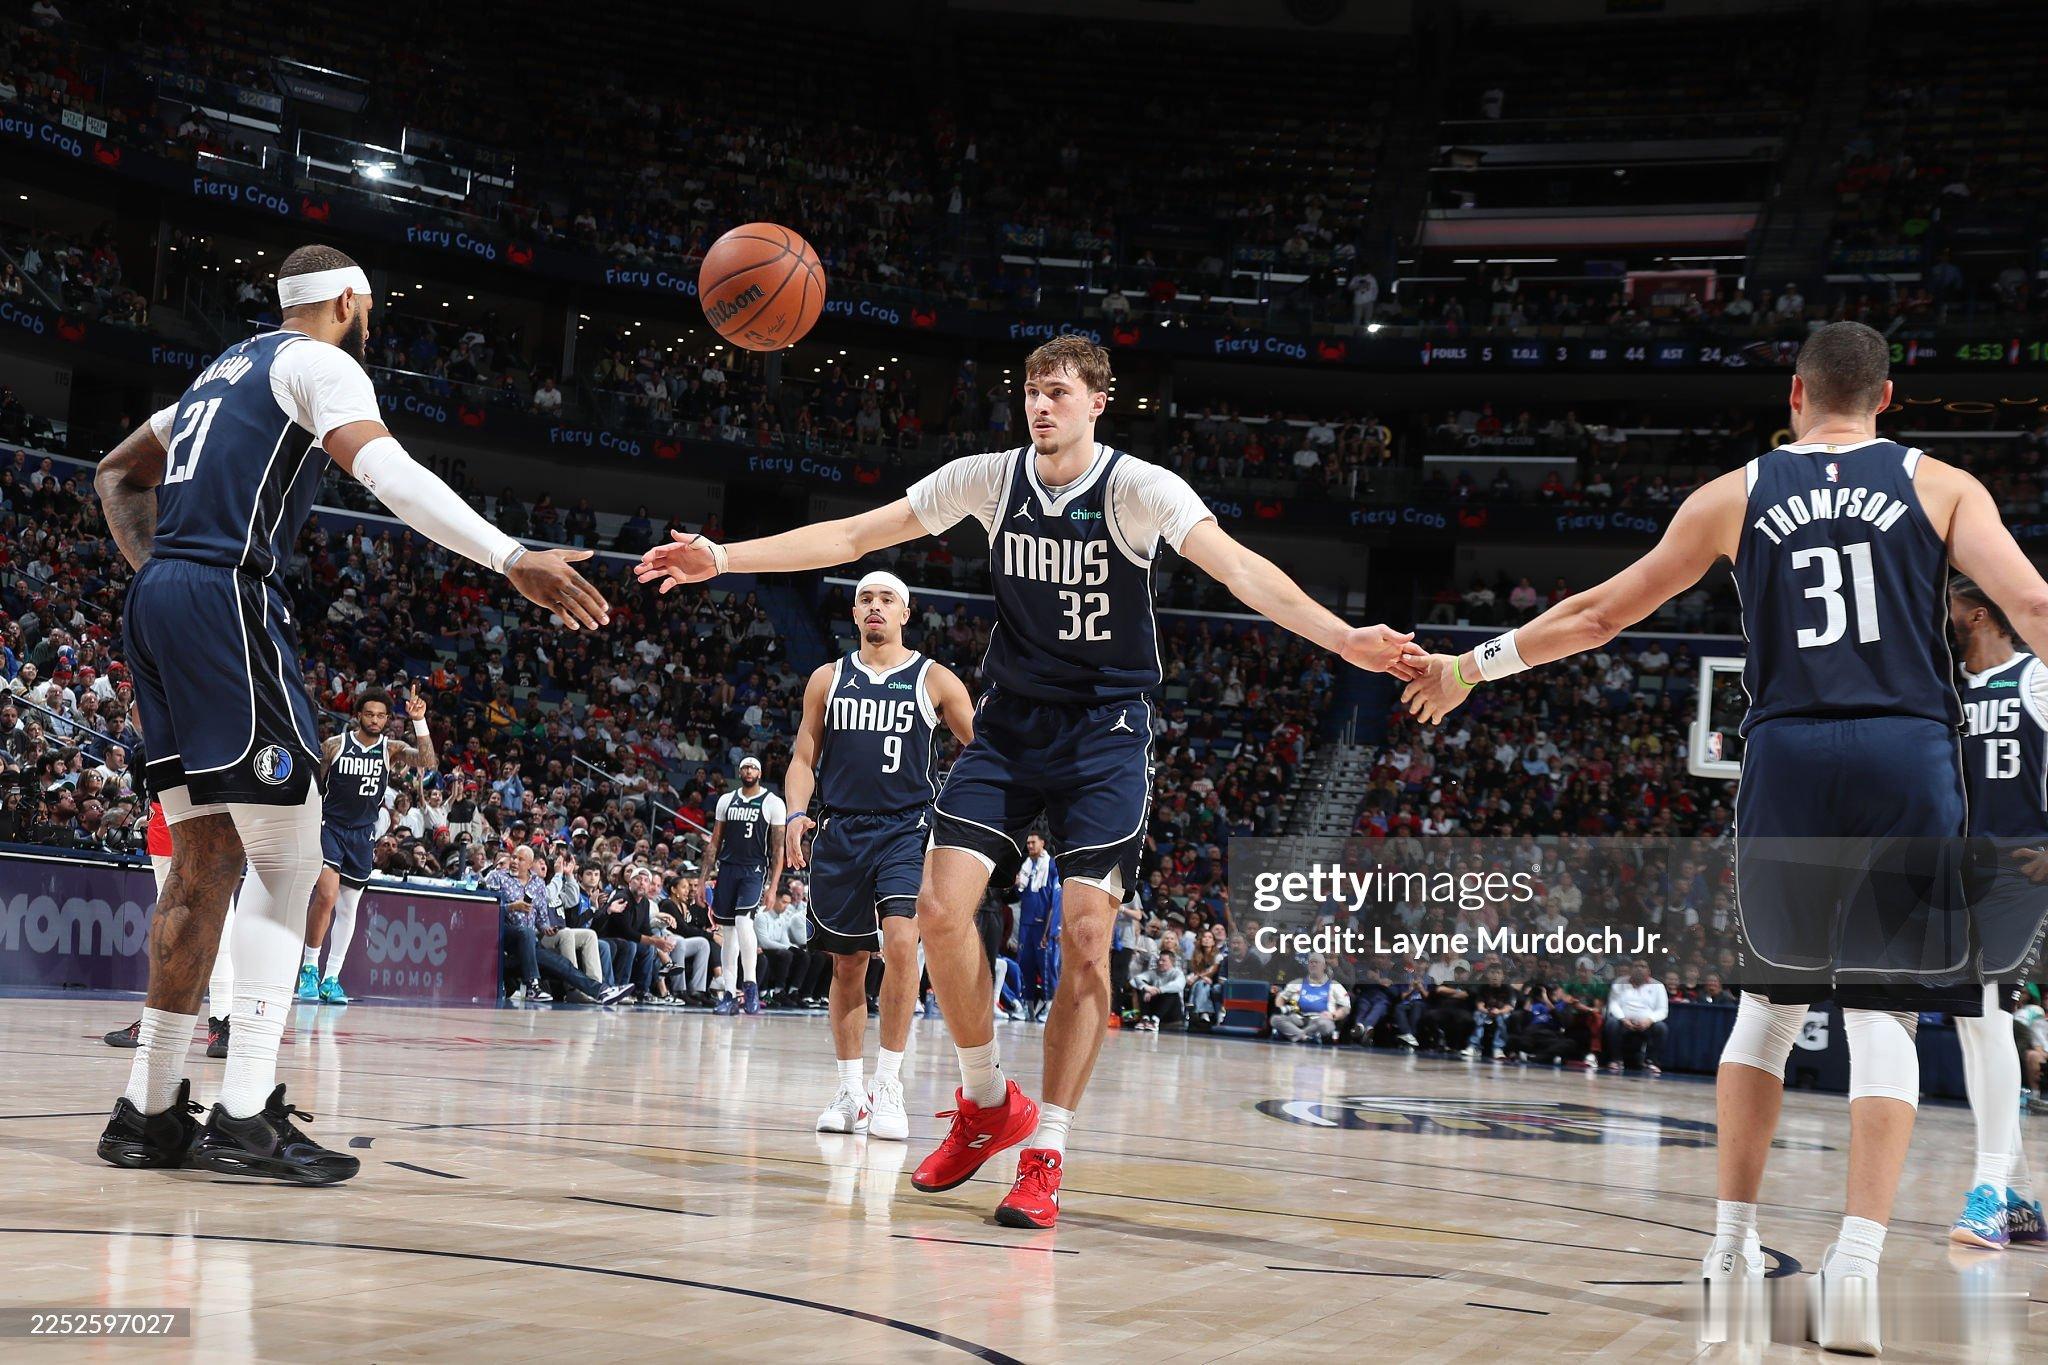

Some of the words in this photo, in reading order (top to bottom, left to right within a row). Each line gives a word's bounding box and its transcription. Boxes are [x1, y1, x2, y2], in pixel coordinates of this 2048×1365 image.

[0, 117, 33, 139] iery
[40, 125, 83, 158] Crab
[193, 178, 238, 201] Fiery
[245, 186, 289, 216] Crab
[407, 226, 450, 248] Fiery
[456, 232, 496, 260] Crab
[606, 269, 650, 288] Fiery
[656, 271, 697, 296] Crab
[0, 302, 45, 335] Crab
[859, 301, 900, 325] Crab
[1009, 322, 1055, 342] Fiery
[152, 347, 195, 369] Fiery
[1215, 339, 1258, 355] Fiery
[1264, 338, 1307, 359] Crab
[1432, 347, 1468, 359] FOULS
[1482, 347, 1493, 361] 5
[1557, 346, 1568, 361] 3
[1625, 346, 1646, 361] 44
[1661, 348, 1684, 360] AST
[1700, 346, 1722, 362] 24
[1955, 343, 2004, 361] 4:53
[405, 396, 447, 424] Crab
[164, 398, 222, 485] 21
[551, 427, 593, 448] Fiery
[600, 432, 640, 457] Crab
[750, 456, 794, 473] Fiery
[800, 457, 842, 482] Crab
[1070, 508, 1102, 520] chime
[1350, 509, 1395, 528] Fiery
[1403, 507, 1446, 529] Crab
[1556, 514, 1605, 534] Fiery
[1611, 511, 1657, 534] Crab
[1754, 487, 1909, 545] THOMPSON
[1004, 531, 1109, 586] MAVS
[1791, 541, 1880, 648] 31
[1058, 590, 1112, 641] 32
[888, 682, 913, 690] chime
[1988, 680, 2018, 689] chime
[833, 697, 915, 733] MAVS
[1963, 698, 2020, 736] AVS
[338, 756, 383, 776] MAVS
[881, 735, 903, 774] 9
[1983, 738, 2020, 779] 13
[358, 776, 380, 796] 25
[727, 806, 760, 822] MAVS
[744, 822, 754, 838] 3
[368, 906, 448, 966] sobe
[371, 971, 444, 988] PROMOS
